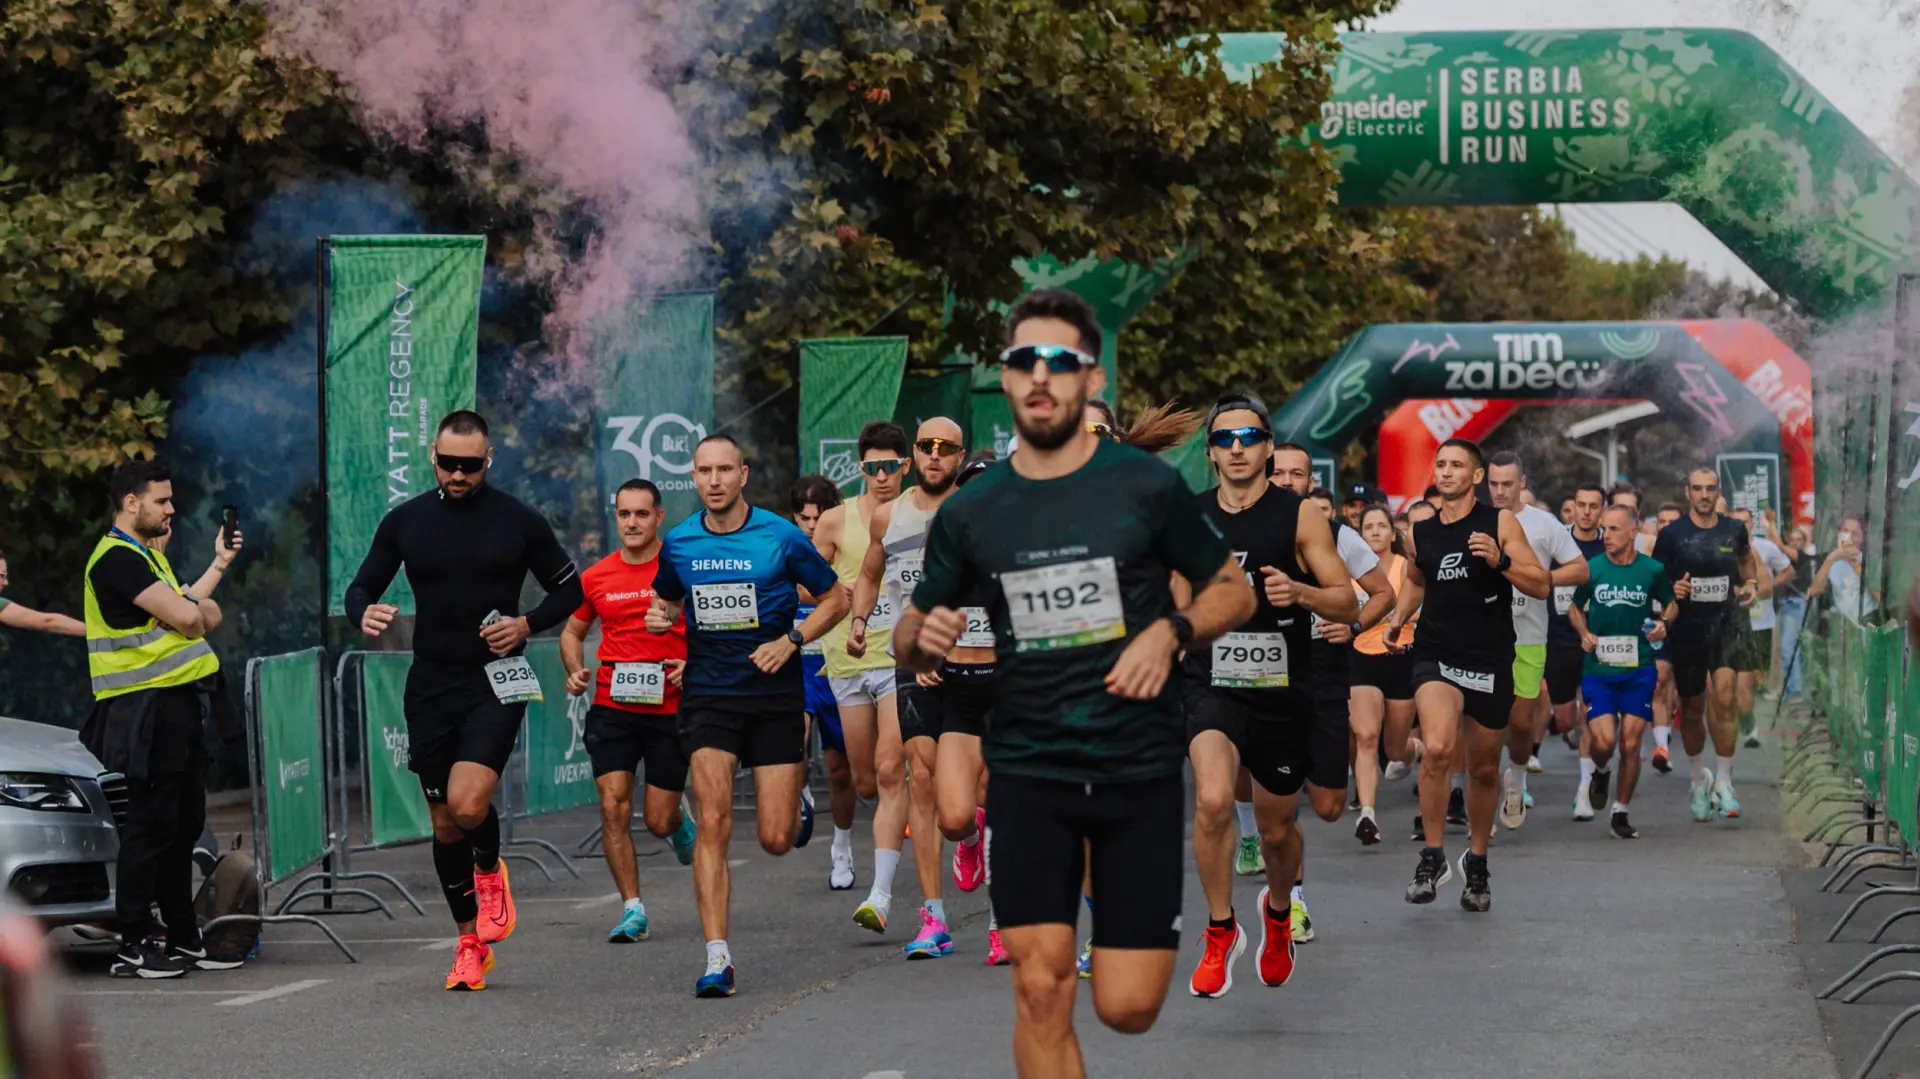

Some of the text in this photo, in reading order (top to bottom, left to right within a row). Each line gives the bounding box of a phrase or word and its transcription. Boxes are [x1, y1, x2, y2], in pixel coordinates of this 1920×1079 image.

[1460, 66, 1582, 96] SERBIA
[1460, 97, 1631, 131] BUSINESS
[1346, 117, 1425, 136] Electric
[1460, 135, 1528, 165] RUN
[388, 273, 415, 511] YATT REGENCY
[419, 397, 428, 447] BELGRADE
[655, 479, 697, 491] GODIN
[691, 559, 753, 571] SIEMENS
[1437, 566, 1468, 581] ADM
[901, 570, 922, 583] 69
[605, 588, 657, 602] Telekom Srb
[1021, 582, 1102, 613] 1192
[1594, 583, 1648, 606] Carlsberg
[1693, 584, 1728, 595] 9393
[697, 594, 752, 610] 8306
[967, 619, 993, 633] 22
[1217, 646, 1283, 663] 7903
[1600, 644, 1634, 654] 1652
[493, 667, 536, 685] 9236
[616, 672, 659, 686] 8618
[383, 726, 410, 750] Schn
